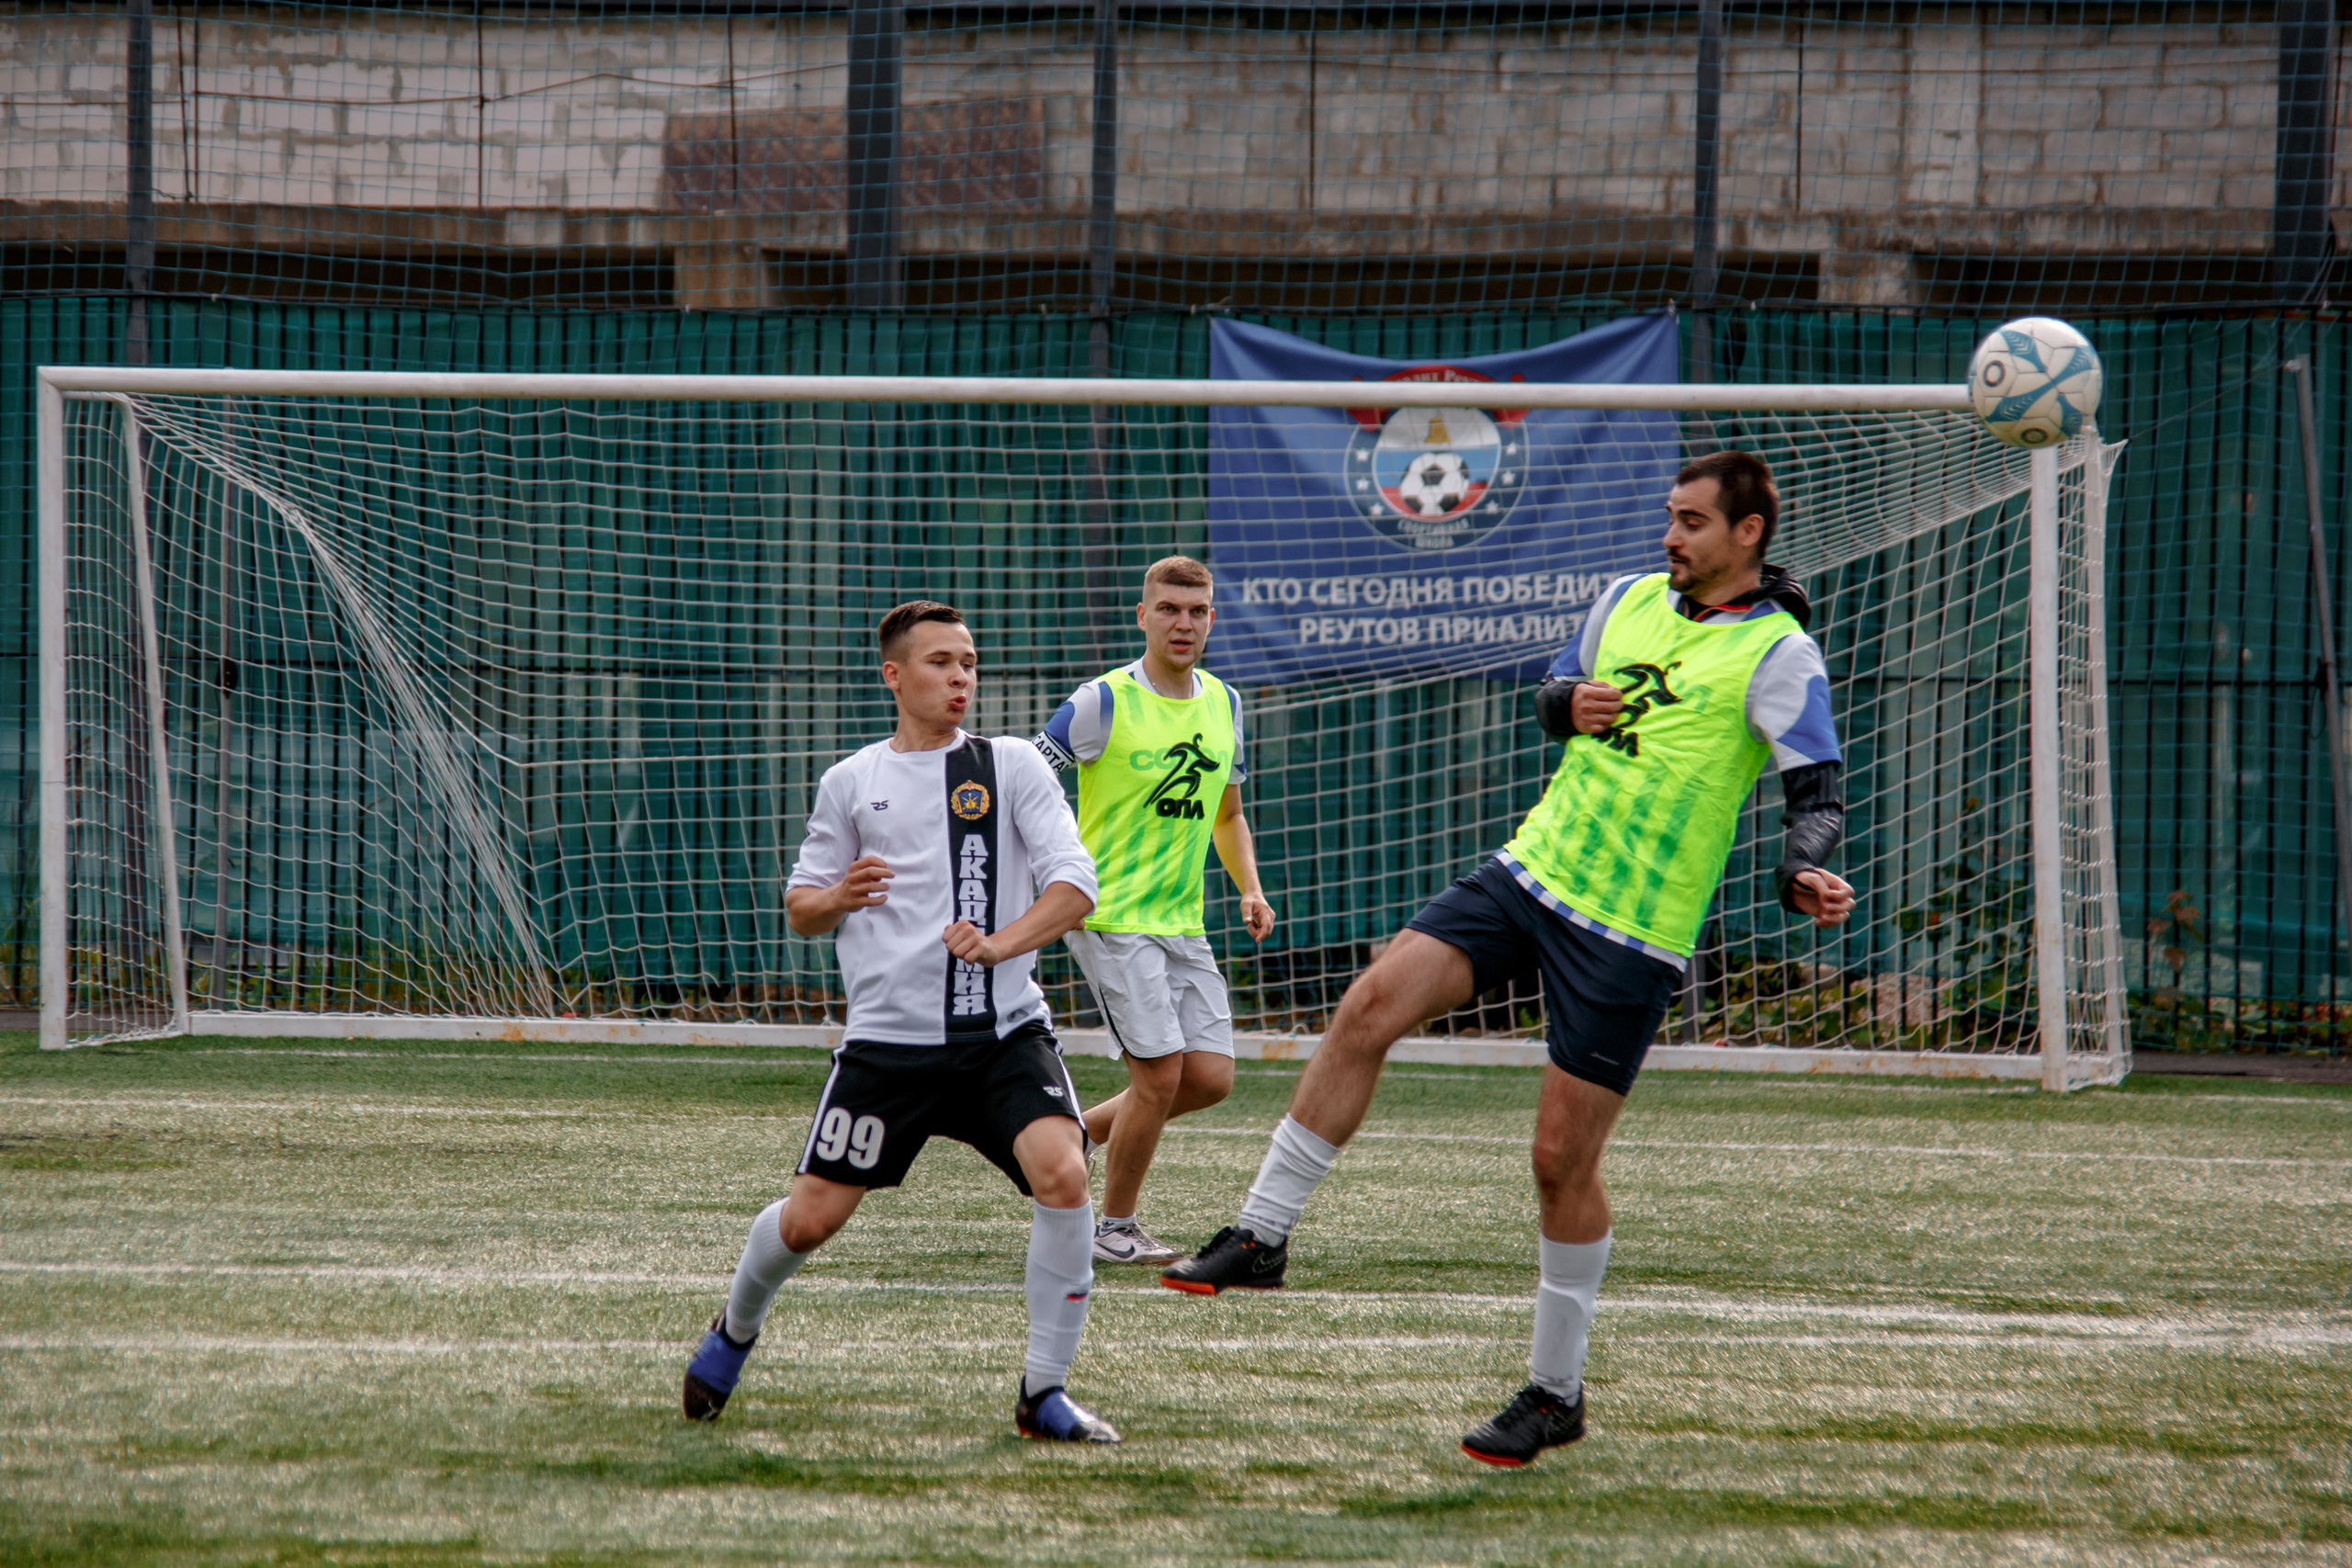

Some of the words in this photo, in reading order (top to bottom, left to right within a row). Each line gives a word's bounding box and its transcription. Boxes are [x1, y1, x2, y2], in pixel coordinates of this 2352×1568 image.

[1242, 577, 1303, 605] КТО
[1309, 575, 1454, 610] СЕГОДНЯ
[1299, 616, 1421, 645] РЕУТОВ
[1031, 735, 1070, 774] CAPTA
[952, 834, 989, 1016] АКАДИЯ
[816, 1106, 886, 1169] 99
